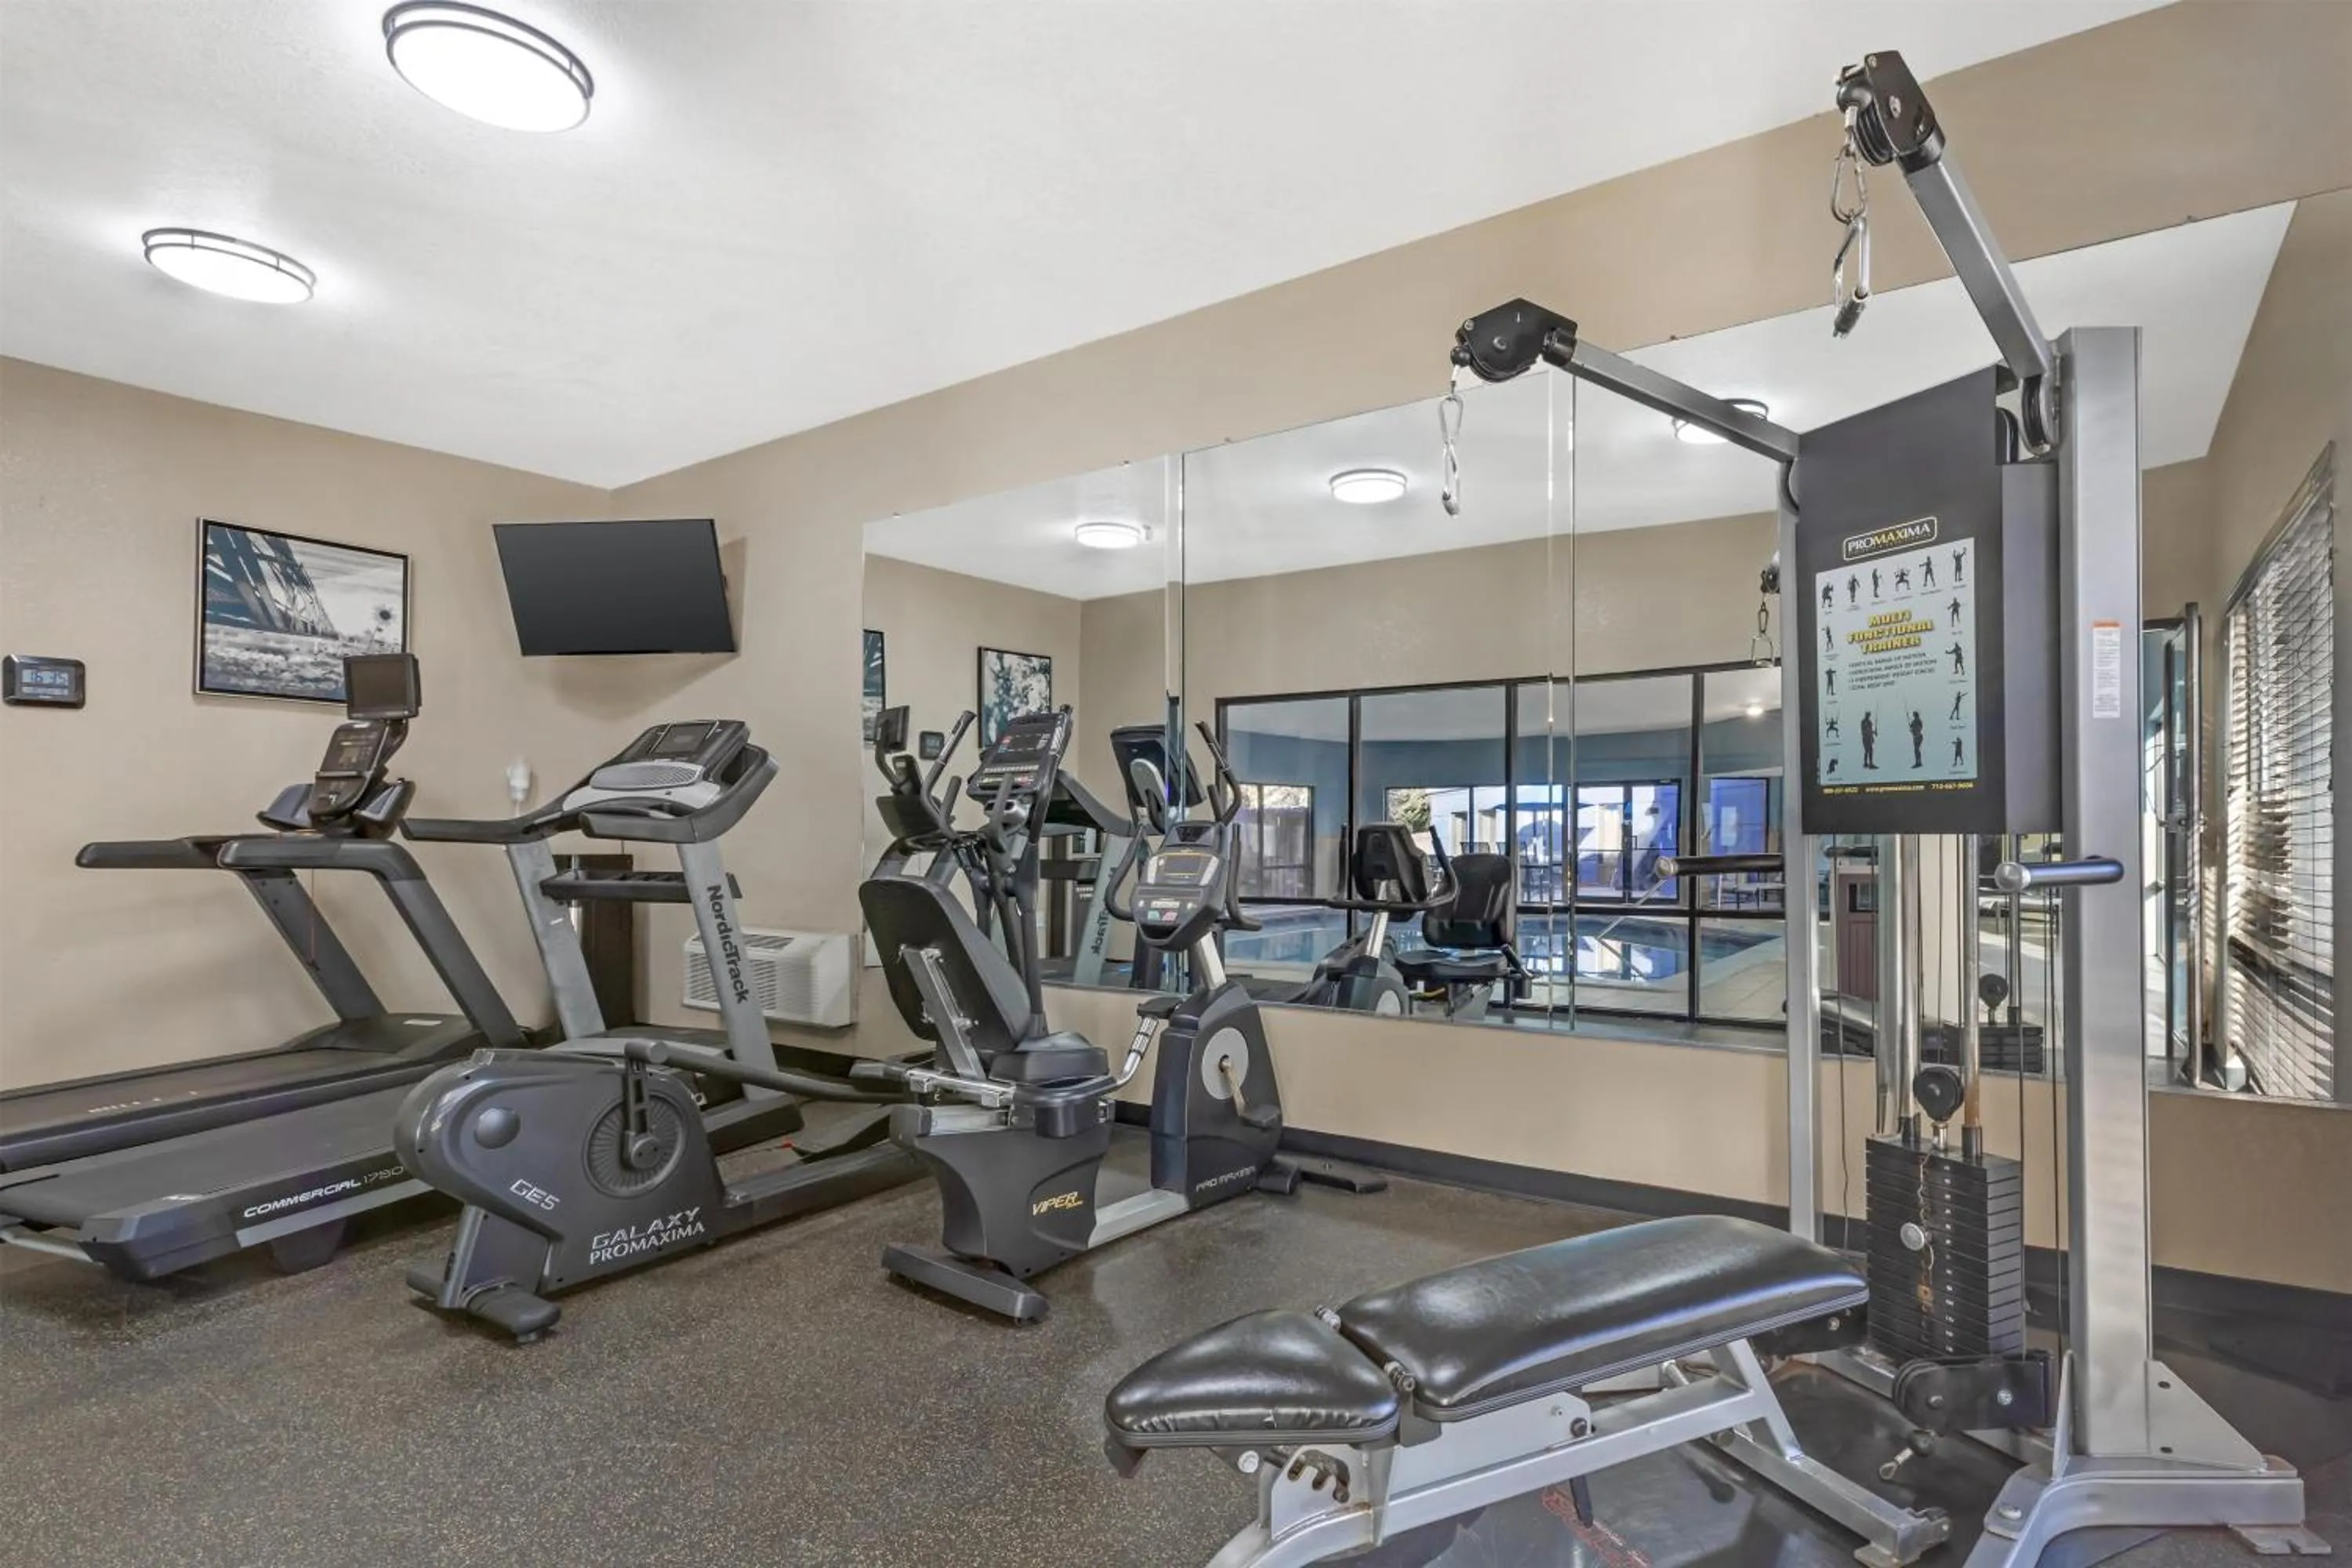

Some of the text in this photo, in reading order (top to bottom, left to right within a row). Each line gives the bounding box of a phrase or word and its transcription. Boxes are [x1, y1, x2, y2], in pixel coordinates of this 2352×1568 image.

[1848, 523, 1931, 551] PROMAXIMA
[1847, 619, 1934, 644] FUNCTIONAL
[1867, 609, 1911, 628] MULTI
[1860, 634, 1921, 655] TRAINER
[707, 884, 750, 1004] NordicTrack
[244, 1178, 361, 1218] COMMERCIAL
[1033, 1191, 1078, 1216] VIPER
[592, 1207, 700, 1249] GALAXY
[590, 1221, 705, 1265] PROMAXIMA
